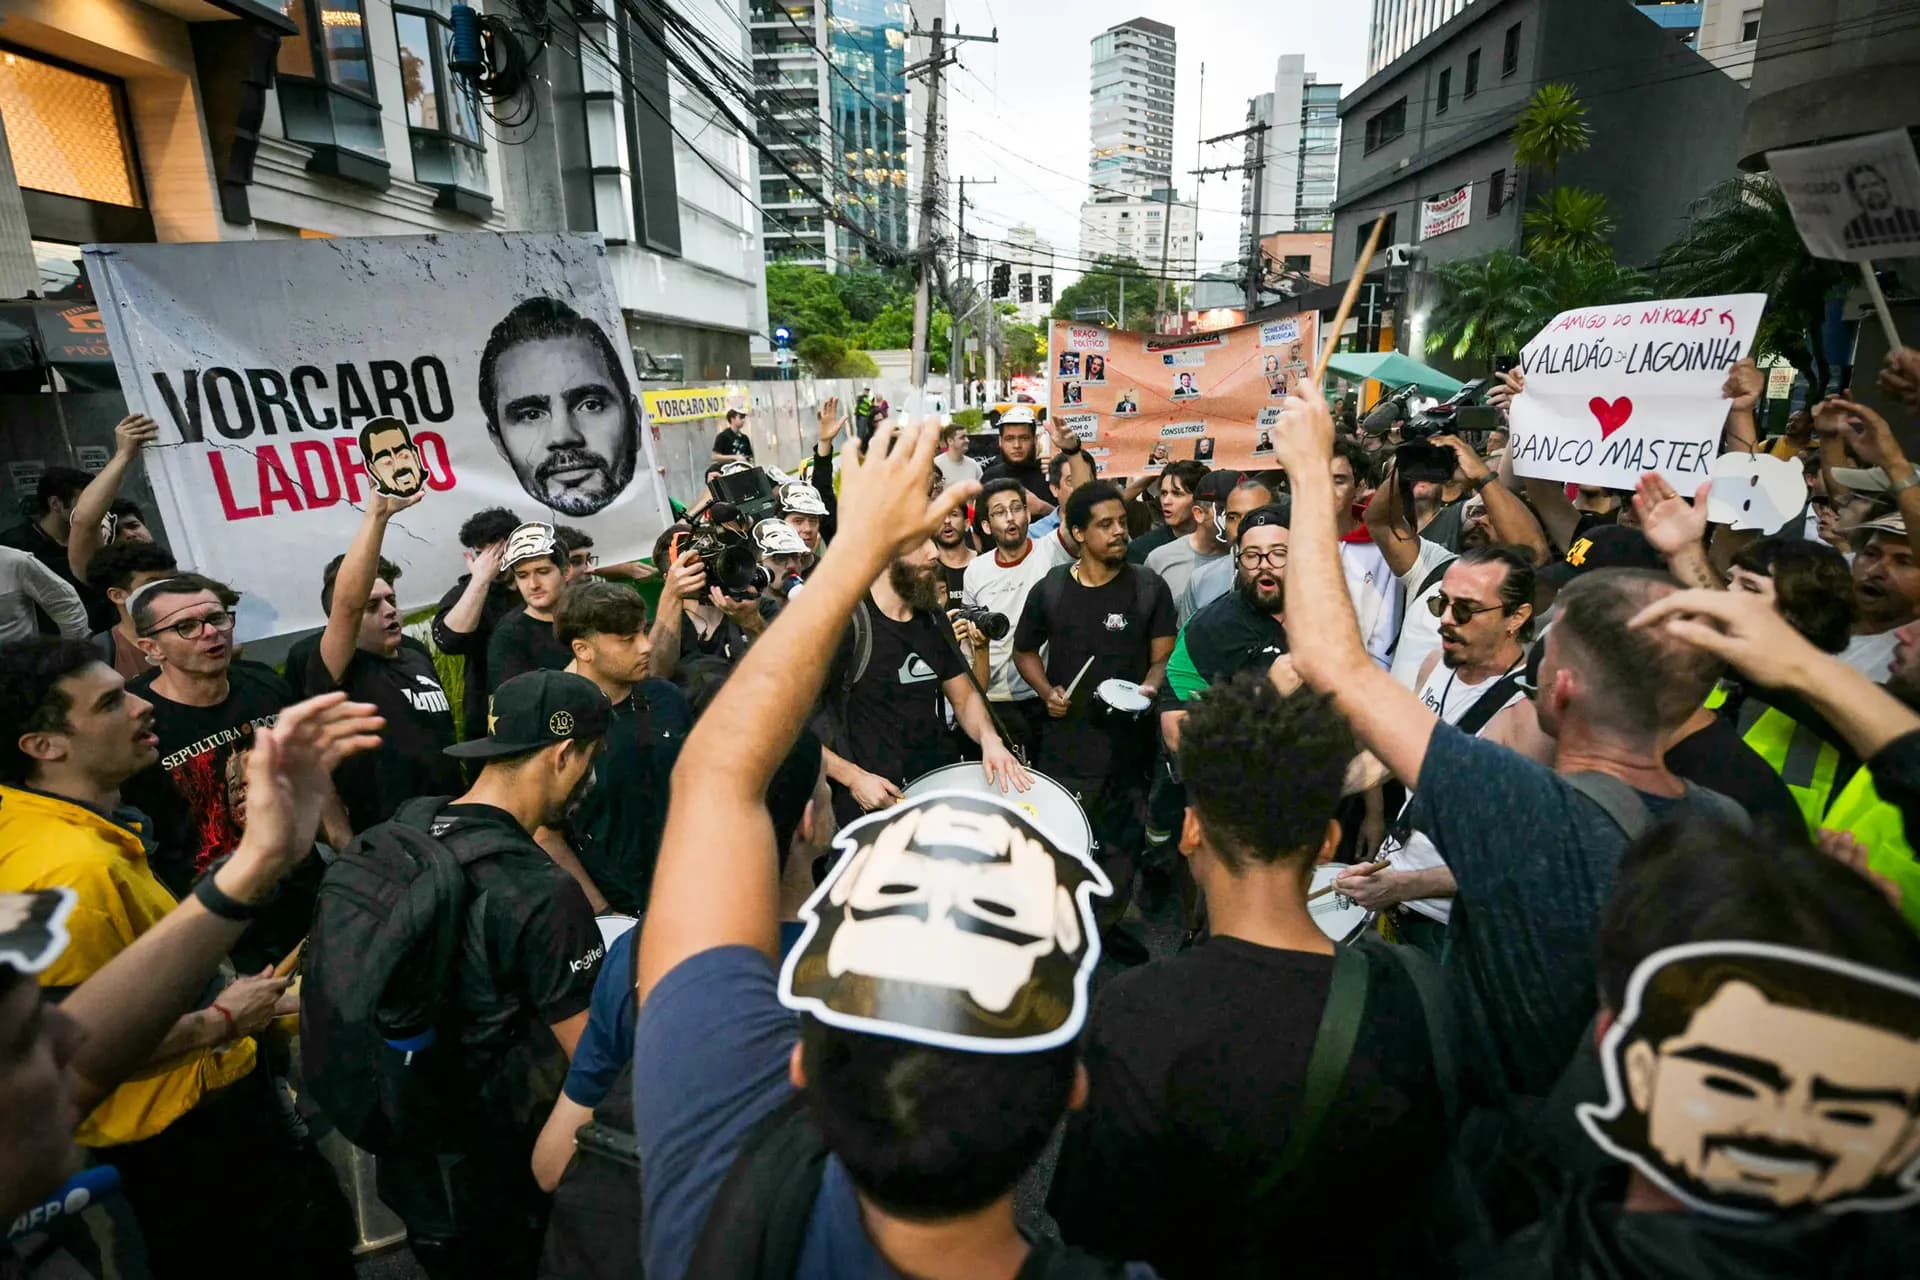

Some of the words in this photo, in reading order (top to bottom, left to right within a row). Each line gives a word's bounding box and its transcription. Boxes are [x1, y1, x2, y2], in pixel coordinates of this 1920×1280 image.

[1554, 314, 1606, 332] AMIGO
[1613, 314, 1632, 327] DO
[1640, 306, 1713, 326] NIKOLAS
[1520, 337, 1613, 376] VALADÃO
[1625, 337, 1742, 375] LAGOINHA
[152, 355, 455, 443] VORCARO
[656, 397, 705, 418] VORCARO
[1161, 424, 1205, 436] CONSULTORES
[1512, 433, 1593, 466] BANCO
[1599, 437, 1714, 475] MASTER
[207, 431, 457, 521] LADRO
[556, 716, 568, 726] 10
[161, 727, 241, 771] SEPULTURA
[7, 1201, 61, 1238] AFP
